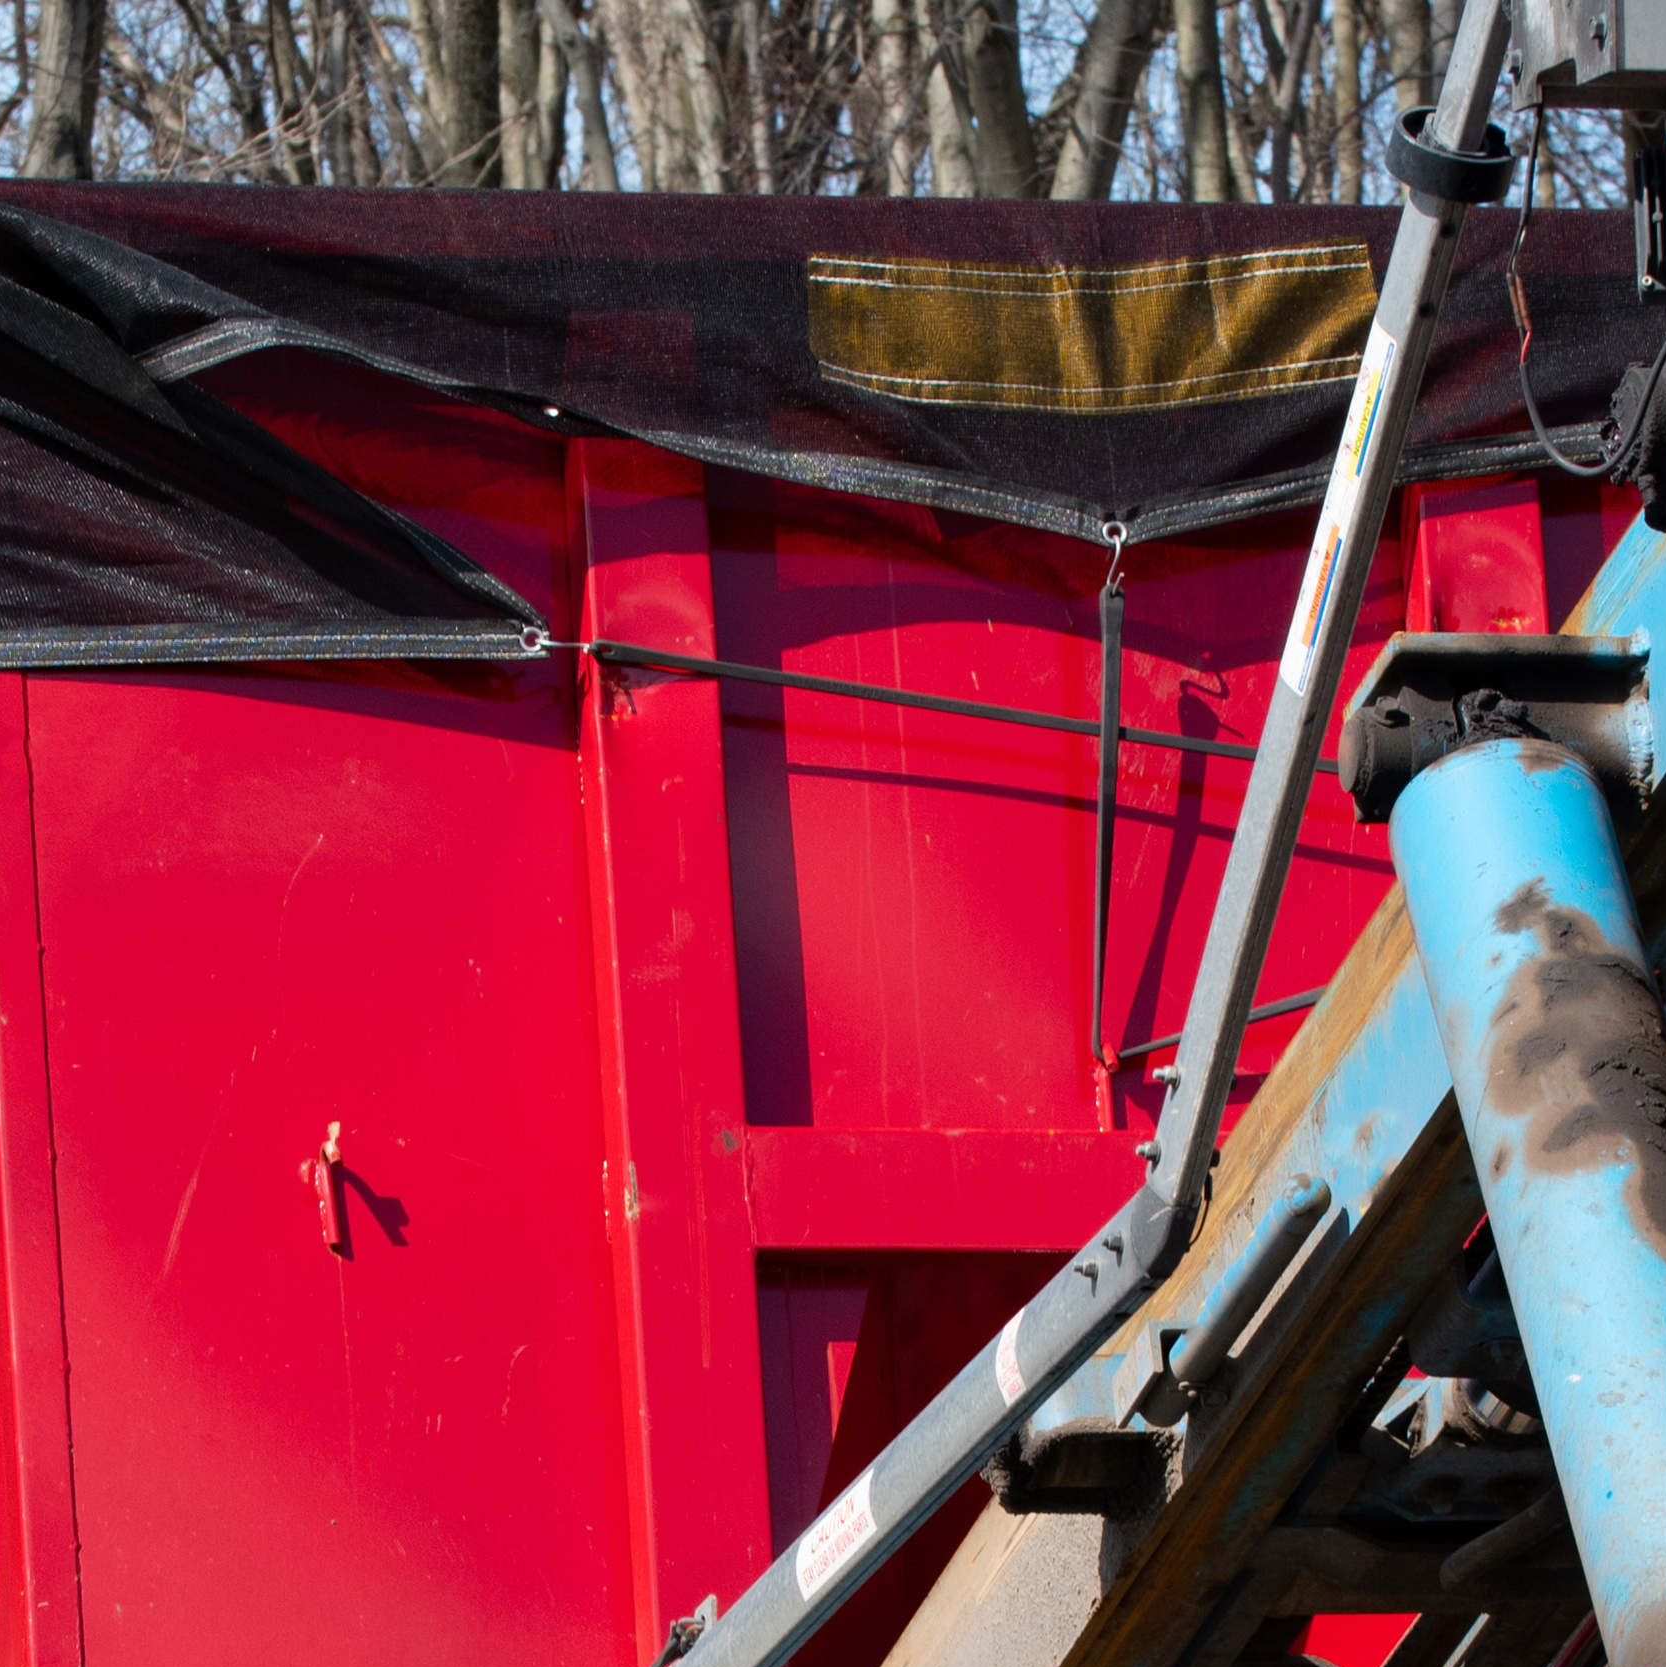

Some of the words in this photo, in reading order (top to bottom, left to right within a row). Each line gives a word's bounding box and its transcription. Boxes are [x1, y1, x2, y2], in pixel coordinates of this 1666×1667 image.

[1353, 406, 1370, 457] CAUTION
[1310, 563, 1330, 620] WARNING
[811, 1489, 856, 1554] CAUTION
